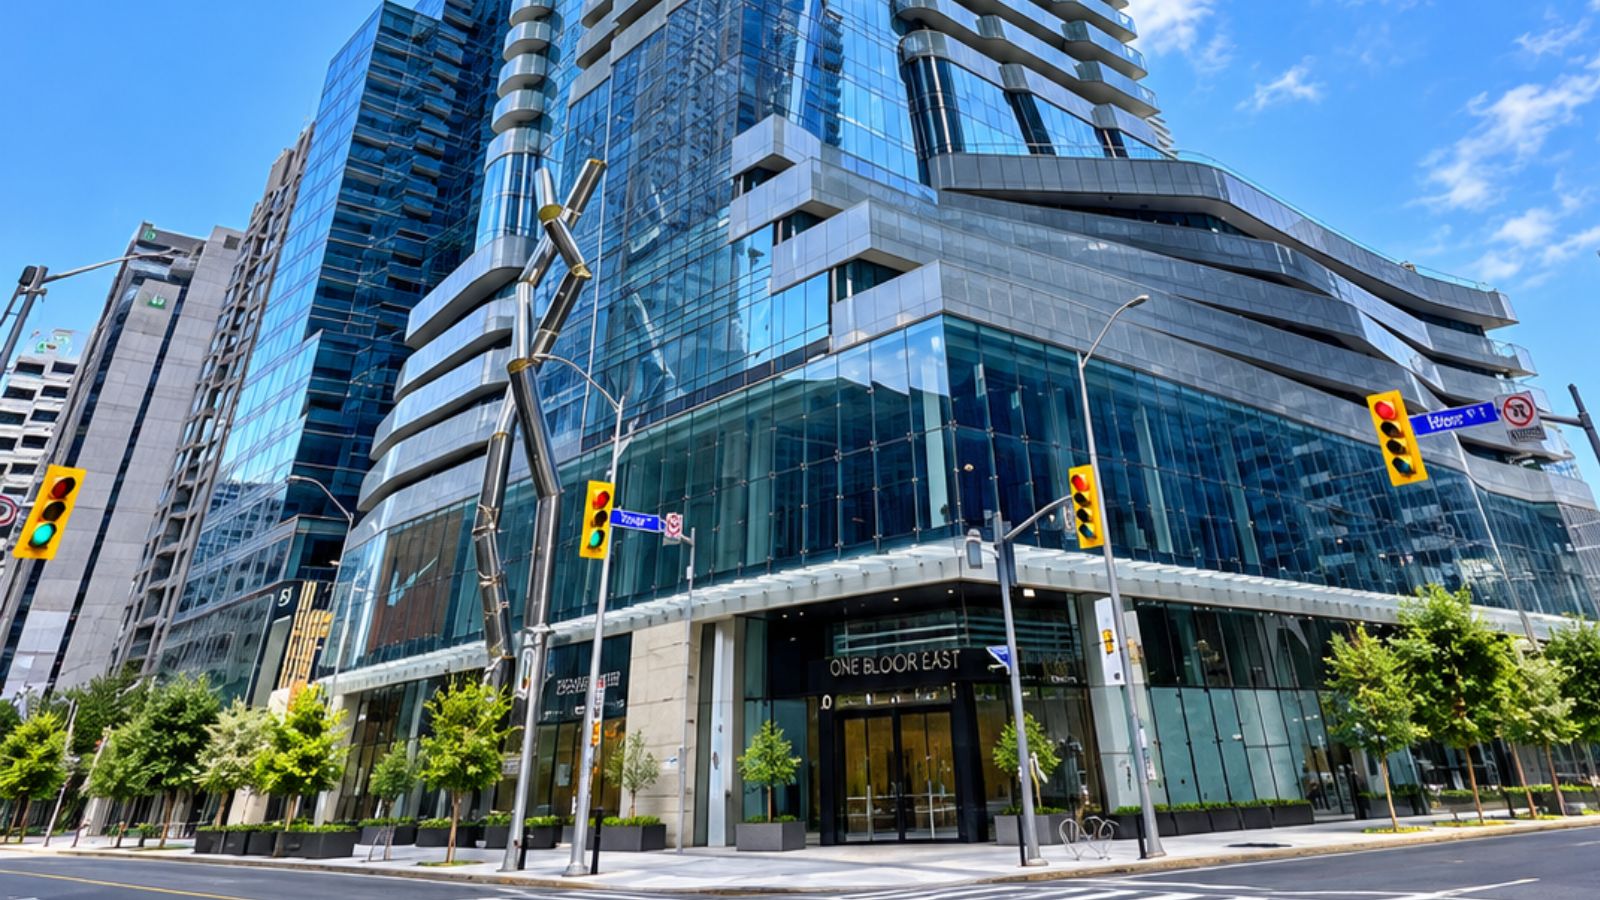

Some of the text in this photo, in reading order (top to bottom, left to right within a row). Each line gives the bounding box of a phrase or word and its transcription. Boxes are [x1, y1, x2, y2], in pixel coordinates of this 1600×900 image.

[830, 649, 960, 676] ONE BLOOR EAST
